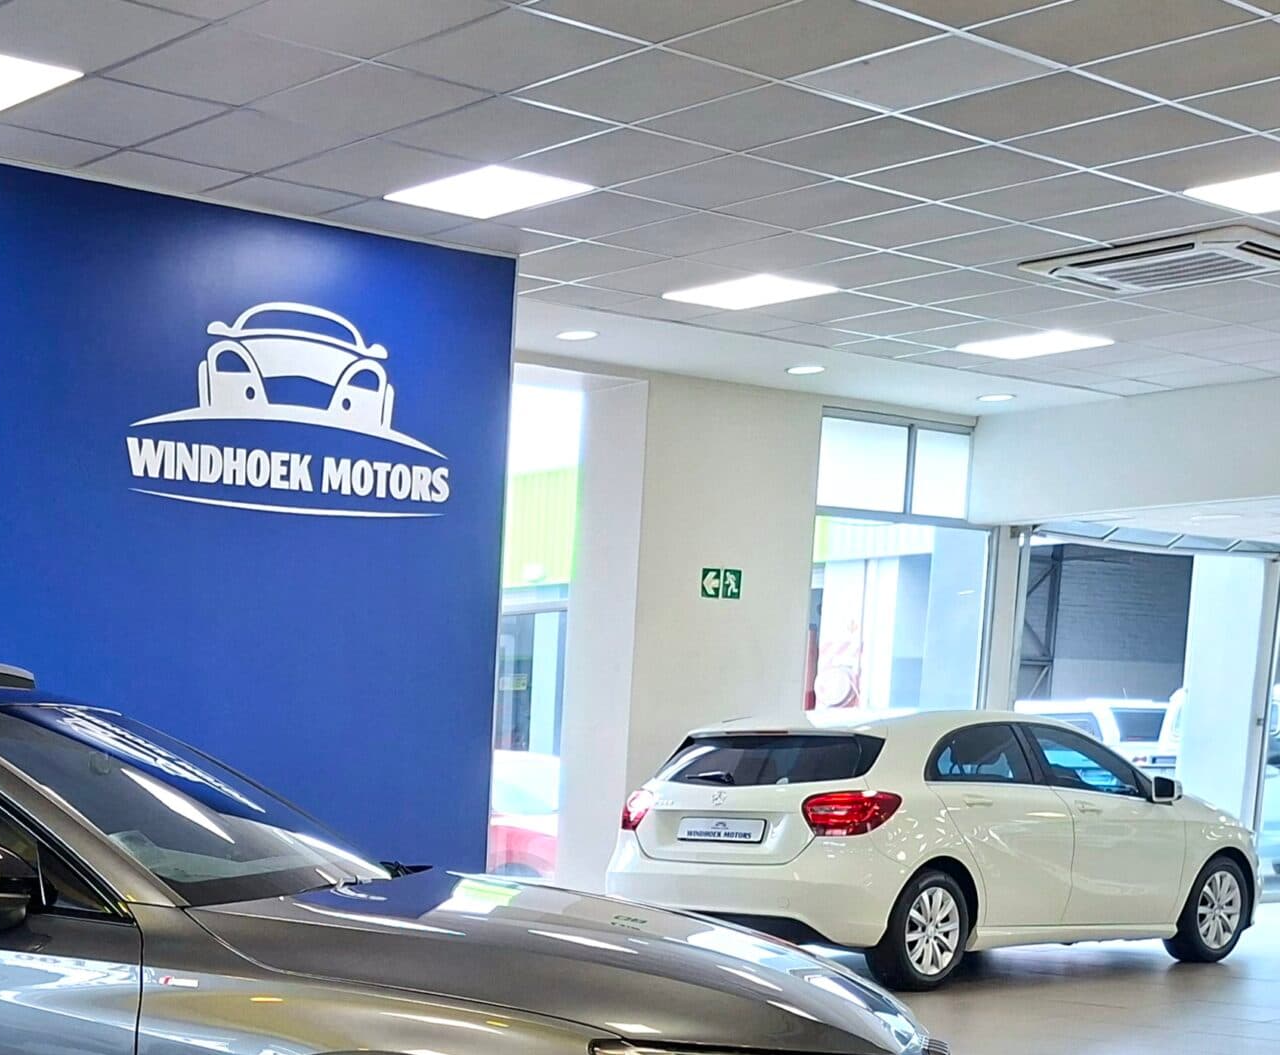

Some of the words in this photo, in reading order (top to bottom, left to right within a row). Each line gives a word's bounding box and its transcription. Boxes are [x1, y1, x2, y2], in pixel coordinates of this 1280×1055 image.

[126, 436, 314, 492] WINDHOEK
[322, 456, 450, 503] MOTORS
[723, 831, 752, 839] MOTORS
